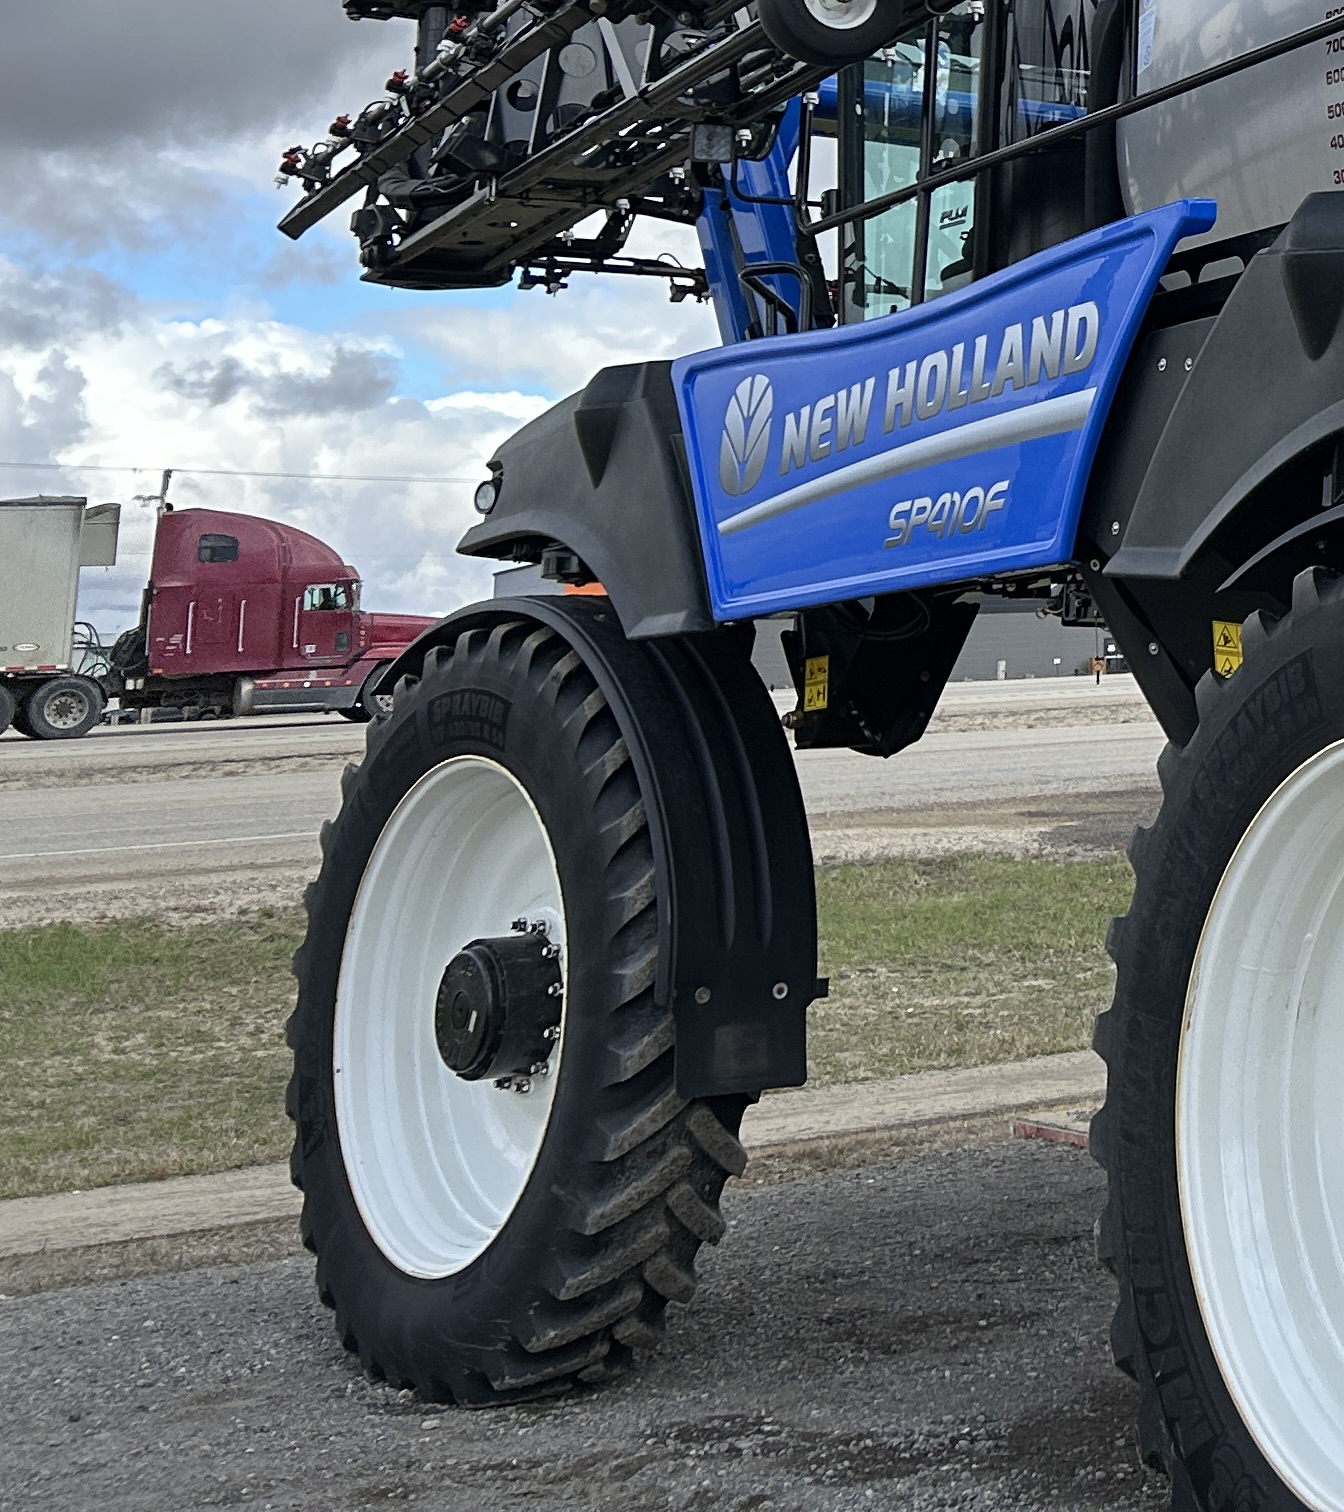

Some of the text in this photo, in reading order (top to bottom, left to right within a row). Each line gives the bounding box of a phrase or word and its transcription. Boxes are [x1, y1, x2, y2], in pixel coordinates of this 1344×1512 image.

[778, 300, 1100, 477] NEW HOLLAND
[883, 480, 1010, 549] SP410F
[432, 691, 505, 726] SPRAYBIB
